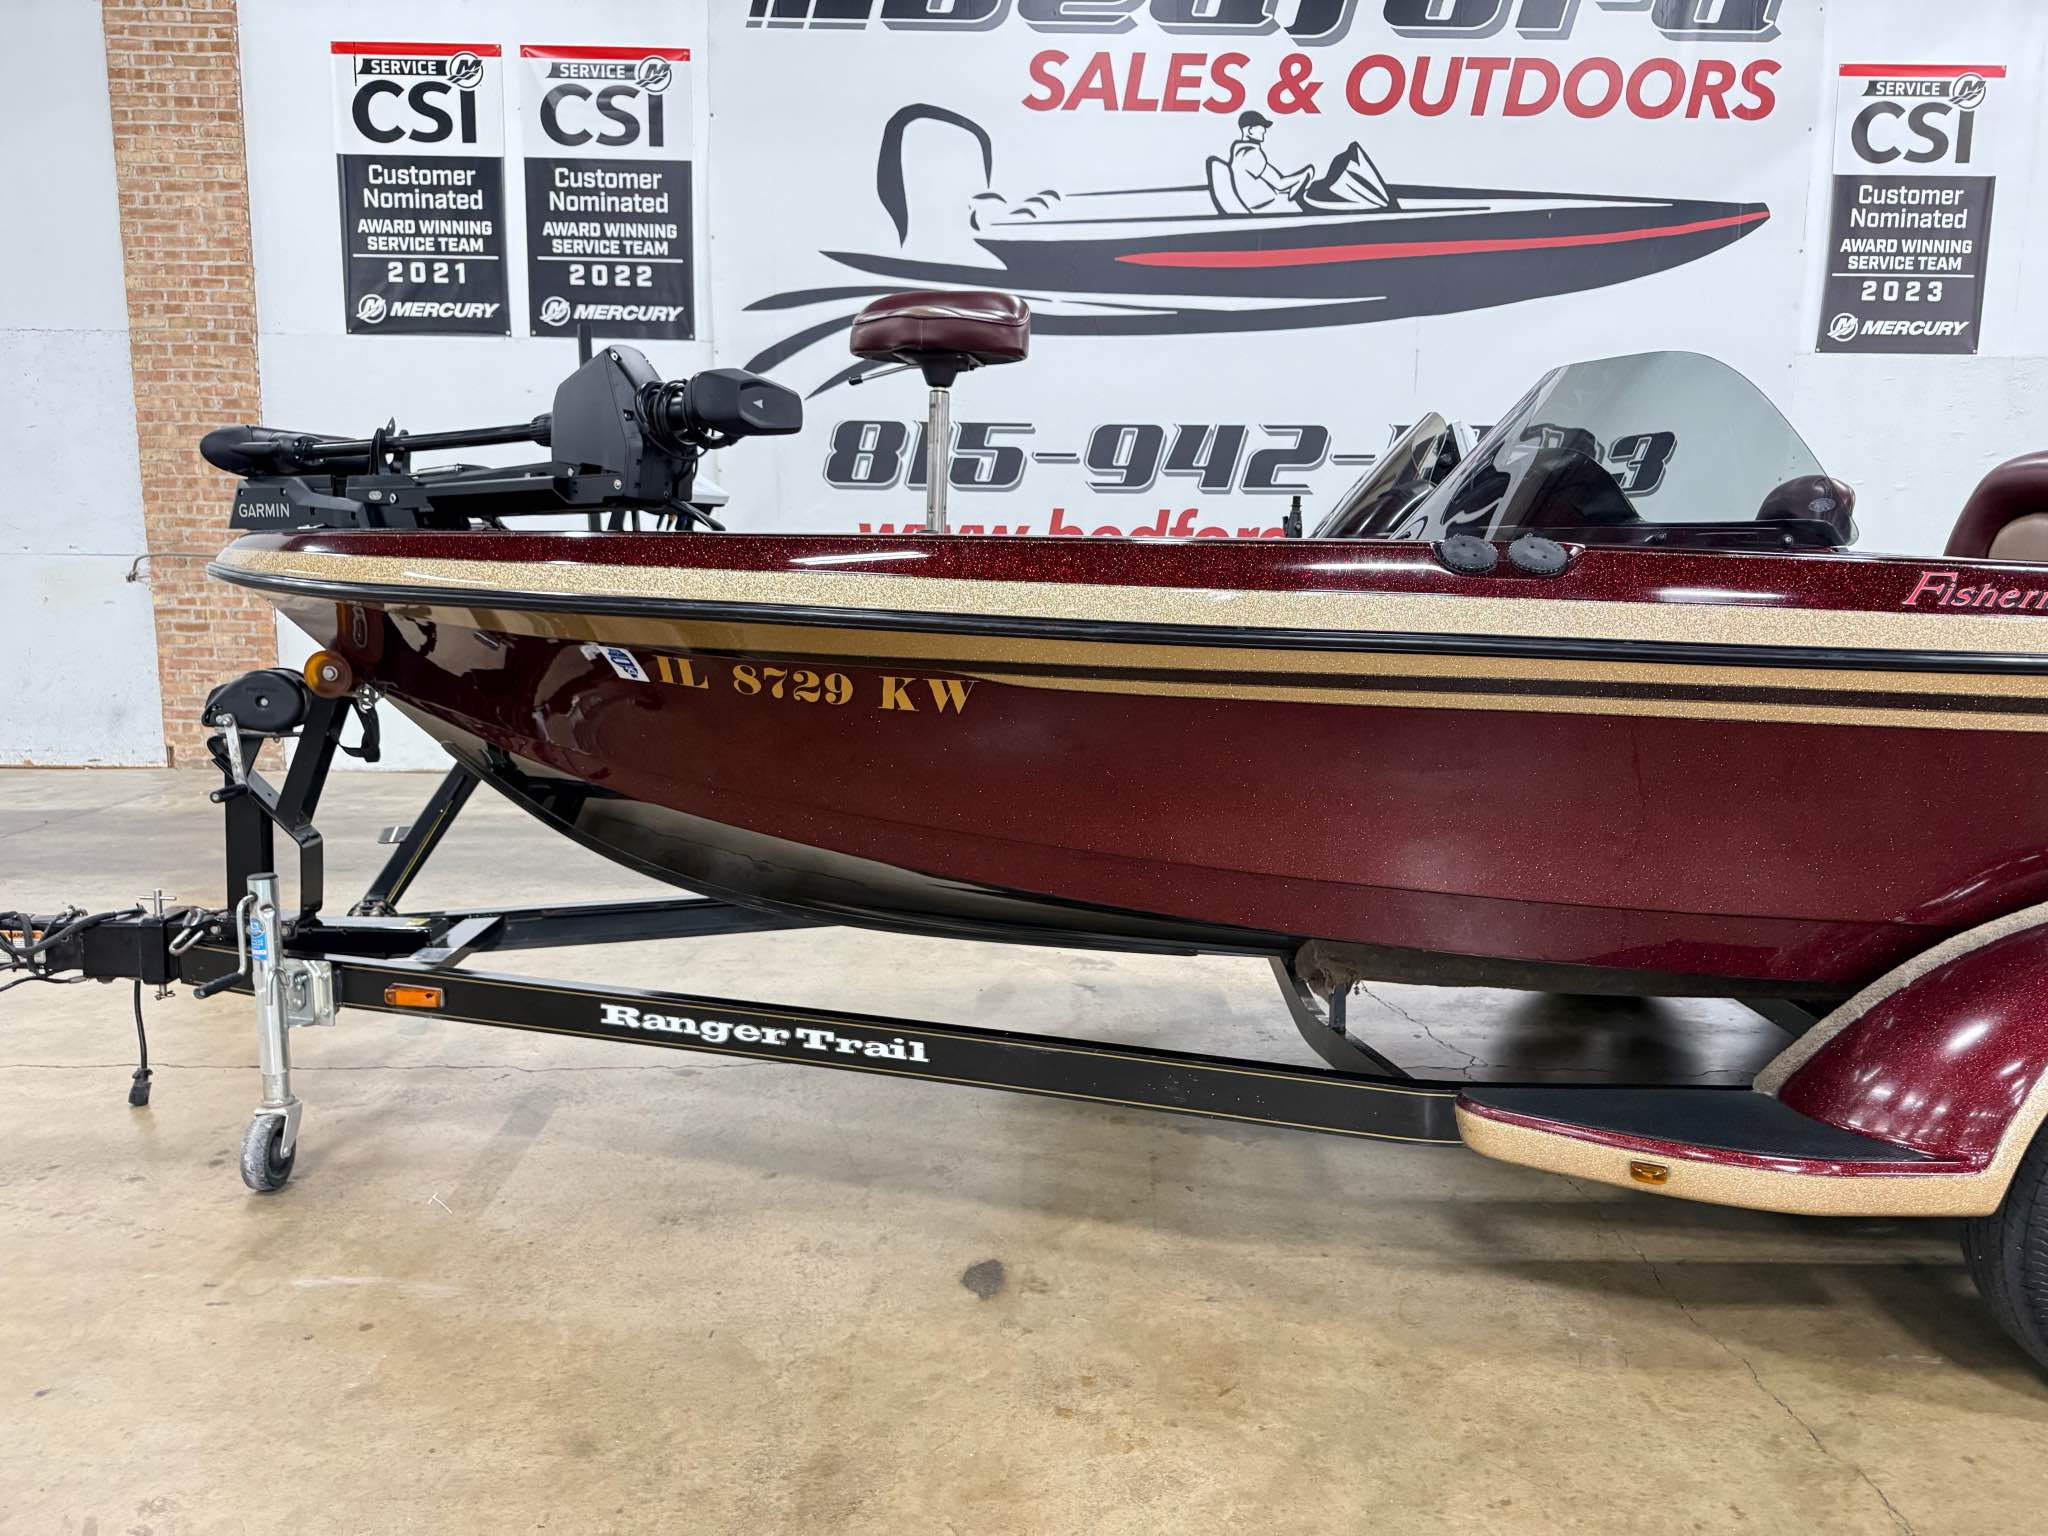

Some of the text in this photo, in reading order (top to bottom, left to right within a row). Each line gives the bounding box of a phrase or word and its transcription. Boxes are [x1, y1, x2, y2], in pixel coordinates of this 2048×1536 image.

[370, 60, 436, 75] SERVICE
[559, 64, 625, 79] SERVICE
[1021, 49, 1782, 120] SALES & OUTDOORS
[1875, 81, 1940, 95] SERVICE
[352, 79, 476, 143] CSI
[540, 83, 664, 147] CSI
[1851, 100, 1975, 163] CSI
[367, 164, 476, 186] Customer
[554, 167, 662, 190] Customer
[362, 187, 483, 211] Nominated
[548, 190, 669, 214] Nominated
[1858, 184, 1963, 204] Customer
[357, 219, 492, 236] AWARD WINNING
[1850, 207, 1967, 228] Nominated
[542, 222, 677, 240] AWARD WINNING
[367, 237, 483, 253] SERVICE TEAM
[551, 239, 668, 255] SERVICE TEAM
[1839, 239, 1972, 253] AWARD WINNING
[387, 261, 466, 284] 2021
[1847, 256, 1961, 270] SERVICE TEAM
[568, 264, 653, 287] 2022
[1860, 281, 1942, 301] 2023
[389, 302, 500, 319] MERCURY
[573, 304, 684, 322] MERCURY
[1860, 321, 1969, 335] MERCURY
[238, 503, 290, 518] GARMIN
[655, 654, 708, 689] IL
[732, 664, 854, 705] 8729
[877, 675, 977, 715] KW
